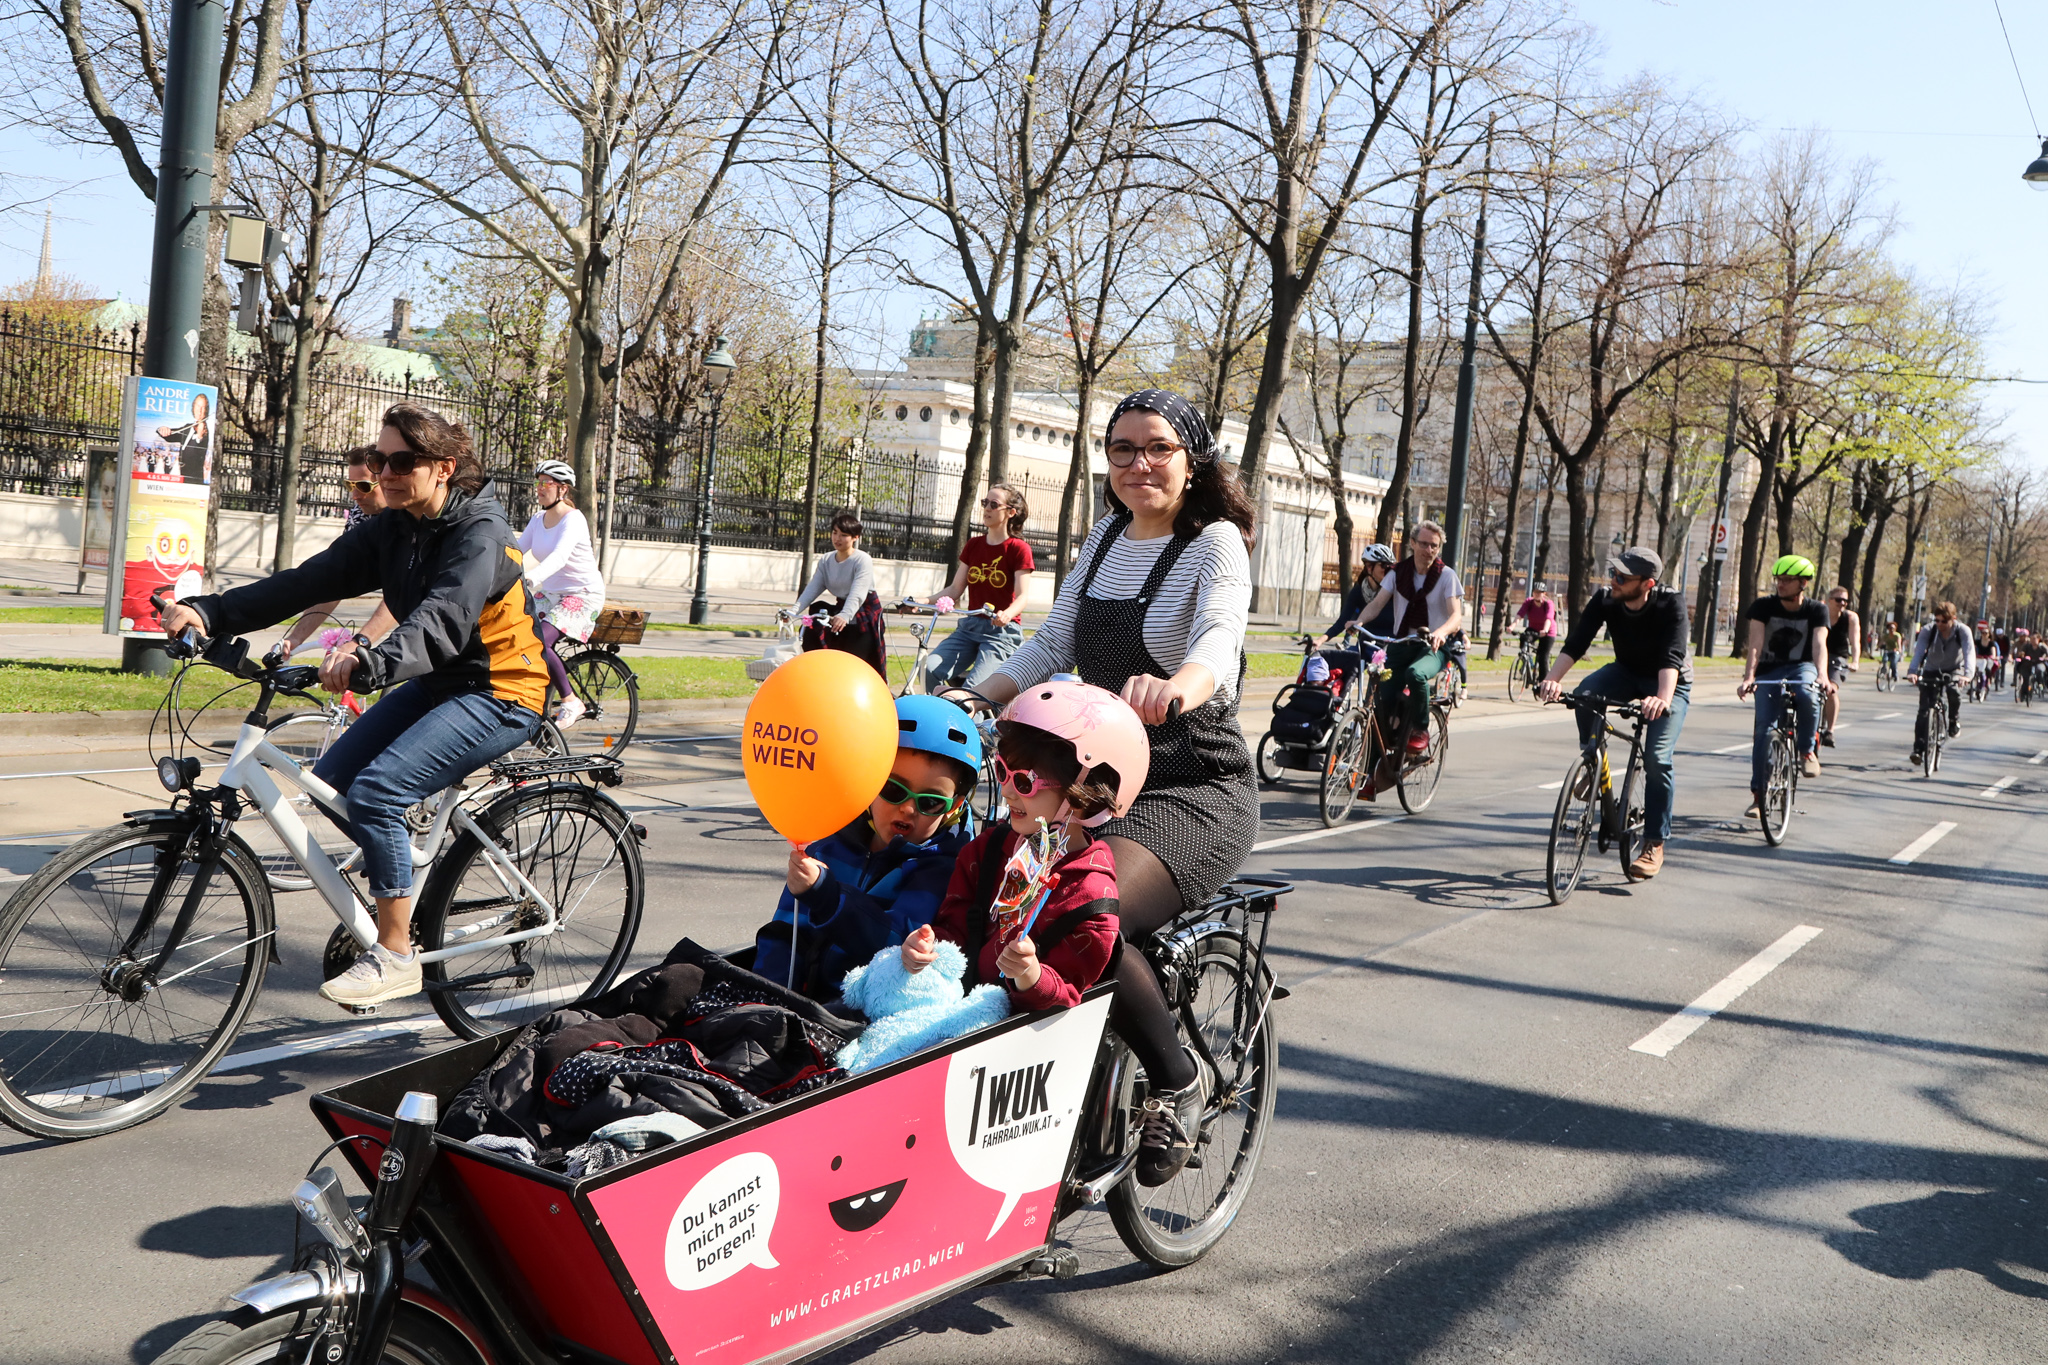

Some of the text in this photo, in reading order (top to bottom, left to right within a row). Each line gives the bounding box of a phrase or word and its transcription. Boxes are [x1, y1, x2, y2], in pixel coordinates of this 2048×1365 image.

[144, 386, 190, 400] ANDRÉ
[144, 397, 190, 415] RIEU
[753, 721, 818, 746] RADIO
[753, 743, 815, 771] WIEN
[988, 1060, 1056, 1129] WUK
[982, 1114, 1053, 1149] FAHRRAD.WUK.AT
[683, 1175, 762, 1234] Du kannst
[687, 1203, 760, 1255] mich aus-
[697, 1222, 756, 1273] borgen!
[770, 1241, 965, 1328] WWW.GRAETZLRAD.WIEN
